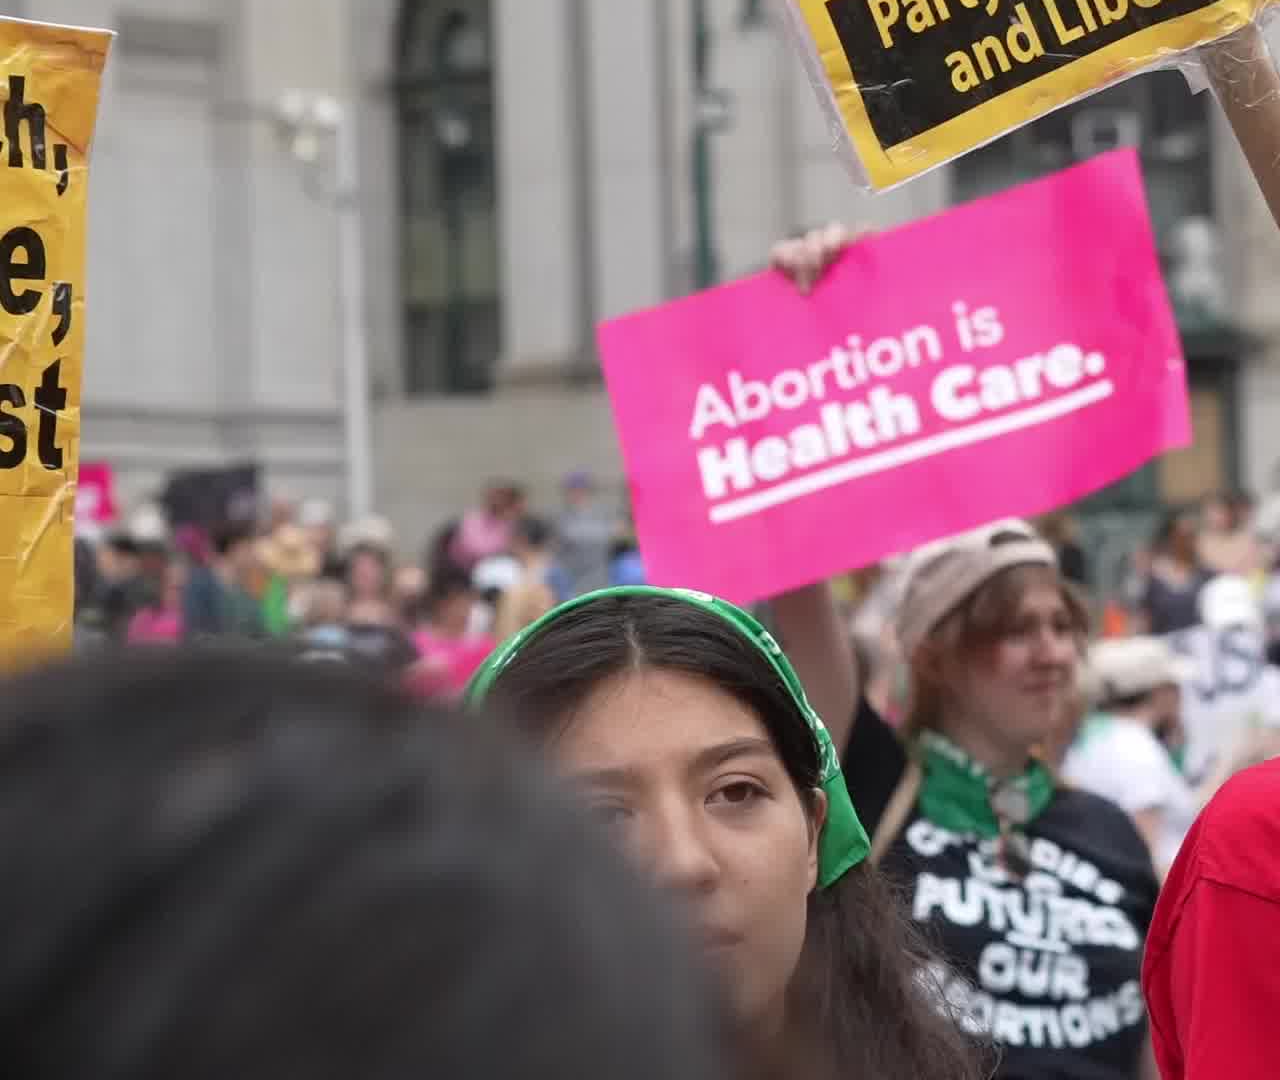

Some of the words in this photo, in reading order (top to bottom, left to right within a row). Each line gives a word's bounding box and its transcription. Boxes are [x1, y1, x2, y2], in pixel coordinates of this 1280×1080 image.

[945, 15, 1042, 92] and
[690, 324, 942, 440] Abortion
[952, 300, 1003, 352] is
[697, 387, 919, 500] Health
[931, 343, 1103, 422] Care.
[979, 942, 1089, 1000] OUR
